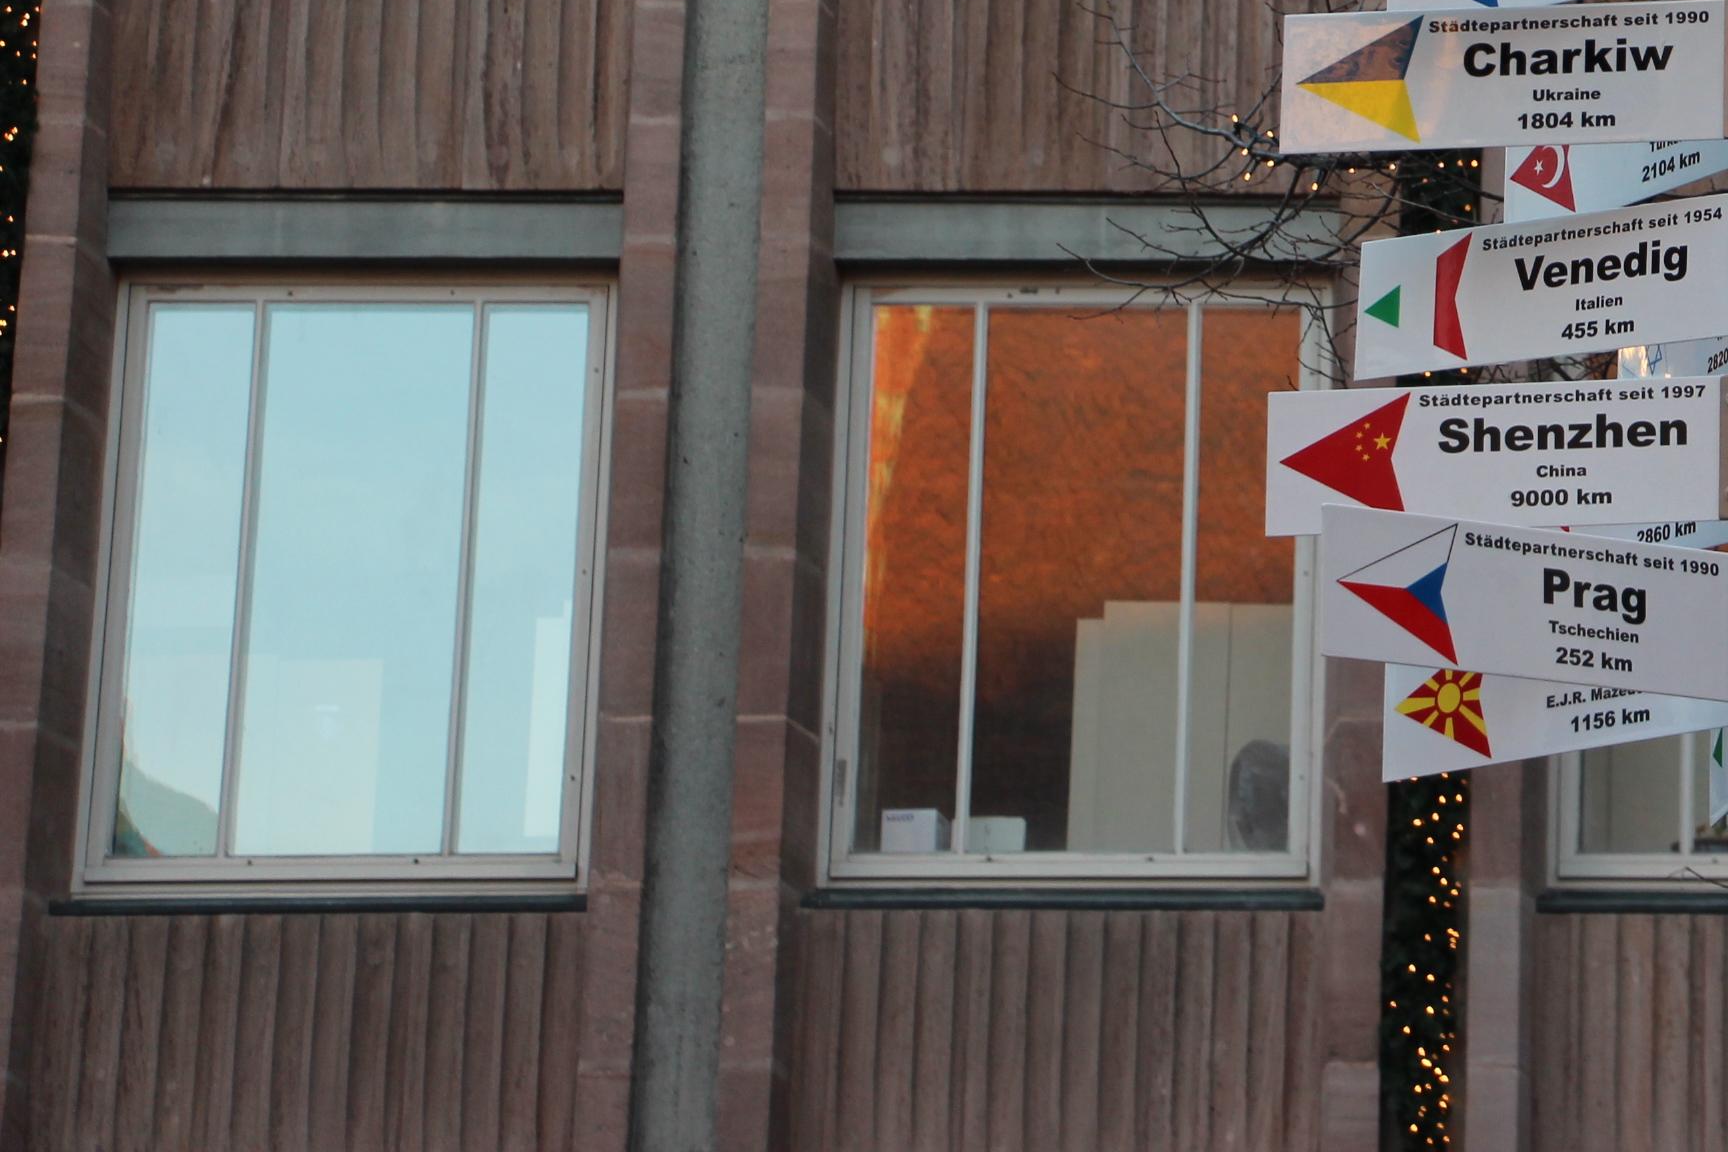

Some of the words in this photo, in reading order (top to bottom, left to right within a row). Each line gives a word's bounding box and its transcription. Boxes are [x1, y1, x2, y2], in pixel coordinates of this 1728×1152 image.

[1429, 14, 1618, 34] Städtepartnerschaft
[1624, 13, 1658, 26] seit
[1665, 10, 1709, 24] 1990
[1464, 38, 1674, 77] Charkiw
[1533, 88, 1601, 102] Ukraine
[1518, 112, 1574, 130] 1804
[1581, 112, 1616, 128] km
[1642, 156, 1675, 182] 2104
[1680, 152, 1700, 169] km
[1482, 218, 1643, 251] Städtepartnerschaft
[1648, 214, 1678, 229] seit
[1684, 207, 1722, 224] 1954
[1514, 240, 1688, 291] Venedig
[1576, 296, 1623, 311] Italien
[1561, 320, 1598, 340] 455
[1605, 319, 1634, 335] km
[1707, 348, 1728, 374] 2820
[1419, 388, 1612, 408] Städtepartnerschaft
[1619, 387, 1654, 400] seit
[1661, 385, 1706, 399] 1997
[1438, 413, 1687, 454] Shenzhen
[1536, 464, 1586, 478] China
[1510, 489, 1568, 507] 9000
[1577, 488, 1612, 505] km
[1637, 524, 1670, 543] 2860
[1675, 521, 1696, 537] km
[1465, 532, 1638, 566] Städtepartnerschaft
[1643, 556, 1674, 571] seit
[1680, 559, 1719, 576] 1990
[1543, 568, 1646, 625] Prag
[1548, 620, 1639, 644] Tschechien
[1556, 647, 1594, 668] 252
[1601, 652, 1632, 672] km
[1546, 691, 1586, 708] E.J.R.
[1571, 710, 1616, 733] 1156
[1622, 708, 1650, 725] km
